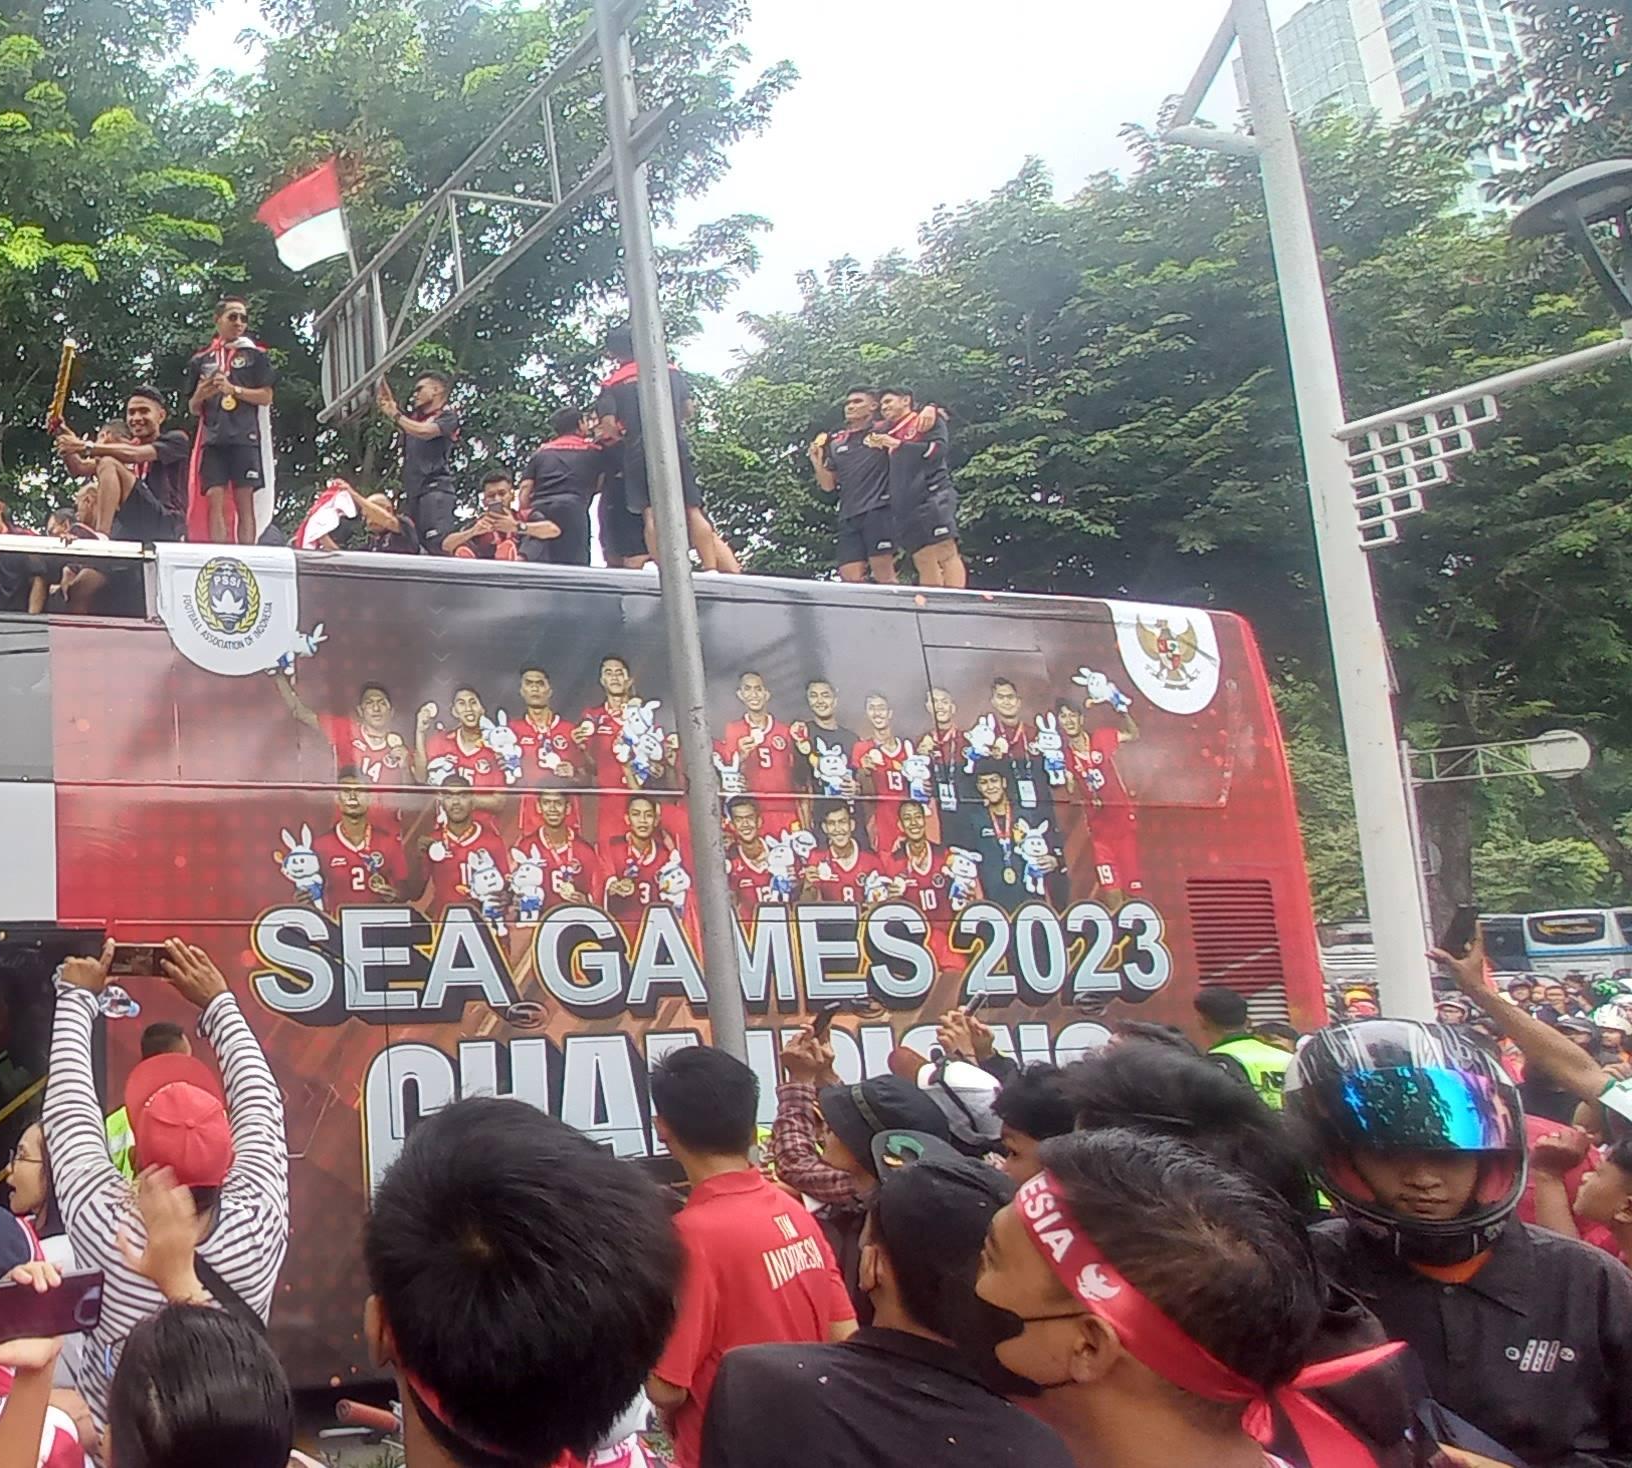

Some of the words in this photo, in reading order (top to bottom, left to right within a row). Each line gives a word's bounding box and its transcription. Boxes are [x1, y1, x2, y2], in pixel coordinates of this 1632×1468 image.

[212, 575, 241, 588] PSSI
[758, 747, 771, 768] 5
[886, 770, 904, 791] 13
[351, 867, 366, 891] 2
[1096, 863, 1115, 886] 19
[639, 882, 651, 904] 3
[919, 888, 938, 910] 10
[254, 906, 512, 1012] SEA
[535, 903, 935, 1006] GAMES
[966, 901, 1171, 993] 2023
[772, 1212, 800, 1241] TIM
[1018, 1170, 1075, 1264] ESIA
